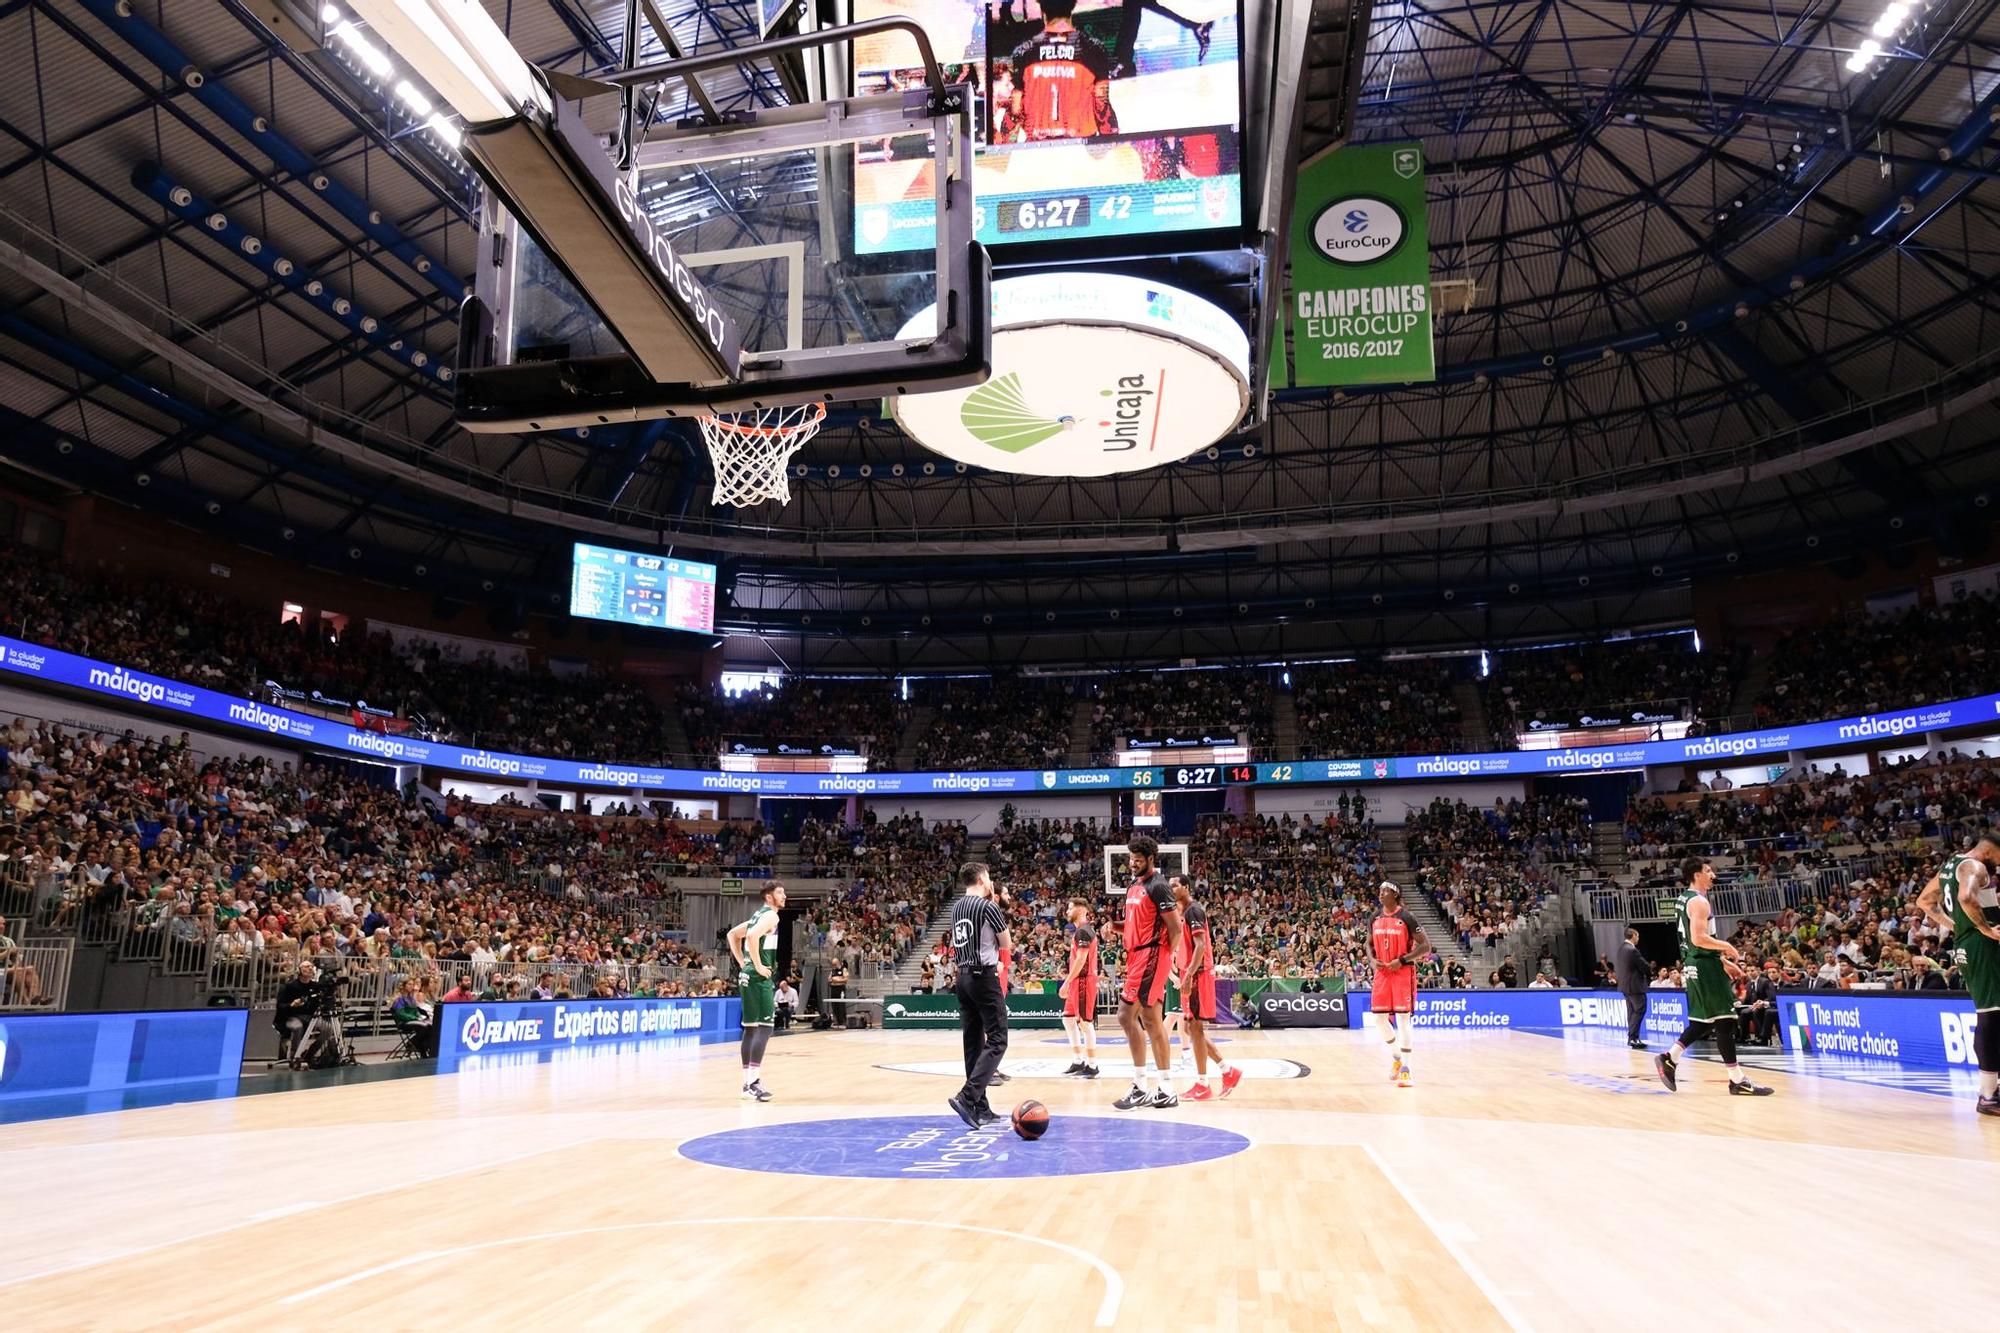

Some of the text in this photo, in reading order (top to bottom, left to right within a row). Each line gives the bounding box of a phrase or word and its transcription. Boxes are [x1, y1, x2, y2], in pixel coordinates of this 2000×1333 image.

[1018, 198, 1080, 230] 6:27
[1099, 195, 1133, 220] 42
[1326, 235, 1391, 250] EuroCup
[615, 178, 725, 352] endesa
[1298, 284, 1426, 319] CAMPEONES
[1307, 314, 1418, 338] EUROCUP
[1322, 340, 1404, 359] 2016/2017
[1099, 373, 1154, 452] Unicaja
[8, 656, 41, 671] redonda
[9, 648, 18, 657] la
[18, 650, 45, 665] ciudad
[166, 694, 192, 707] redonda
[174, 689, 196, 701] ciudad
[1920, 717, 1950, 726] redonda
[1926, 710, 1951, 720] ciudad
[290, 726, 312, 737] redonda
[296, 721, 315, 731] ciudad
[1760, 740, 1788, 748] redonda
[1766, 734, 1790, 742] ciudad
[1068, 774, 1110, 785] UNICAJA
[1132, 771, 1152, 785] 56
[1177, 767, 1215, 785] 6:27
[1232, 768, 1250, 781] 14
[1271, 765, 1292, 780] 42
[1139, 792, 1159, 800] 6:27
[1137, 803, 1157, 817] 14
[955, 925, 968, 940] 64
[1384, 938, 1389, 950] 3
[1264, 997, 1344, 1012] endesa
[1431, 997, 1467, 1011] most
[1650, 998, 1683, 1016] La elección
[554, 1001, 701, 1044] Expertos en aerotermia
[1410, 1012, 1510, 1028] portive choice
[1811, 1003, 1860, 1028] The most
[1645, 1014, 1685, 1036] más deportiva
[1816, 1031, 1899, 1057] sportive choice
